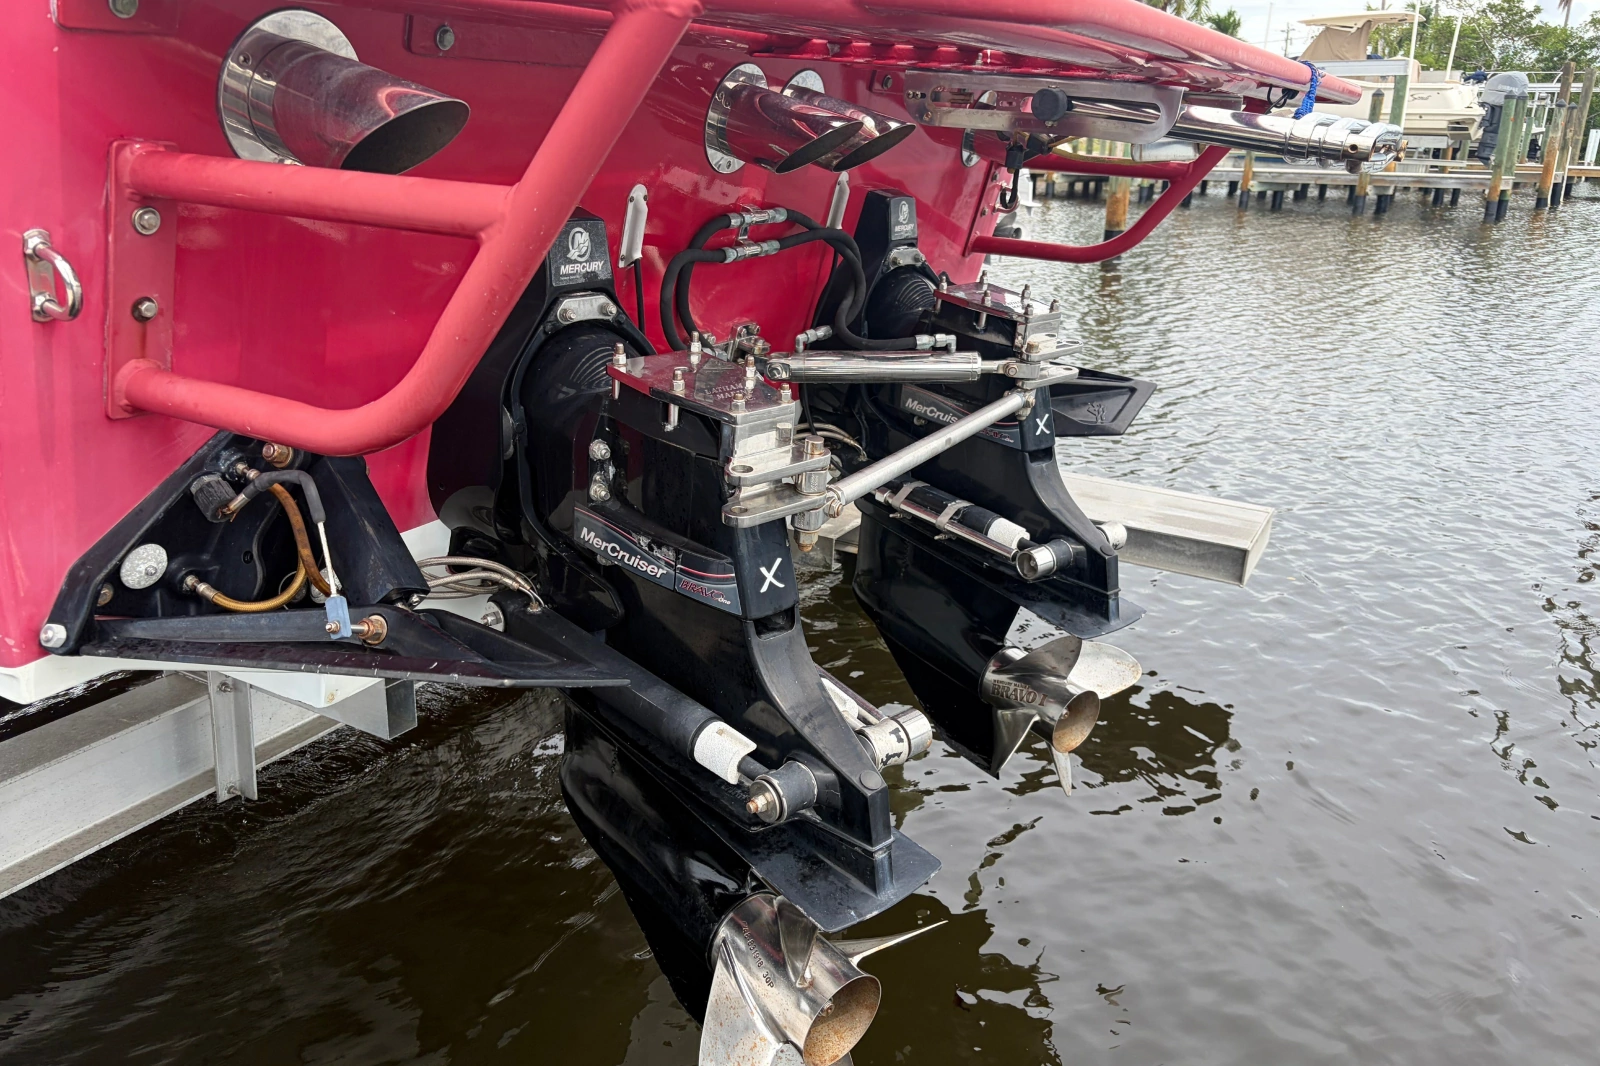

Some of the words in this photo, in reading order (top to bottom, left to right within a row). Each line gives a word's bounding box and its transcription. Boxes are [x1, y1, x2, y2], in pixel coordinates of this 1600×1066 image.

[895, 224, 914, 232] MERCURY
[560, 260, 604, 275] MERCURY
[705, 383, 744, 395] LATHAM
[905, 398, 958, 424] MerCruis
[1036, 413, 1050, 436] X
[580, 527, 666, 579] MerCruiser
[759, 557, 785, 593] X
[679, 578, 725, 600] BRAVO
[991, 684, 1037, 703] BRAVO
